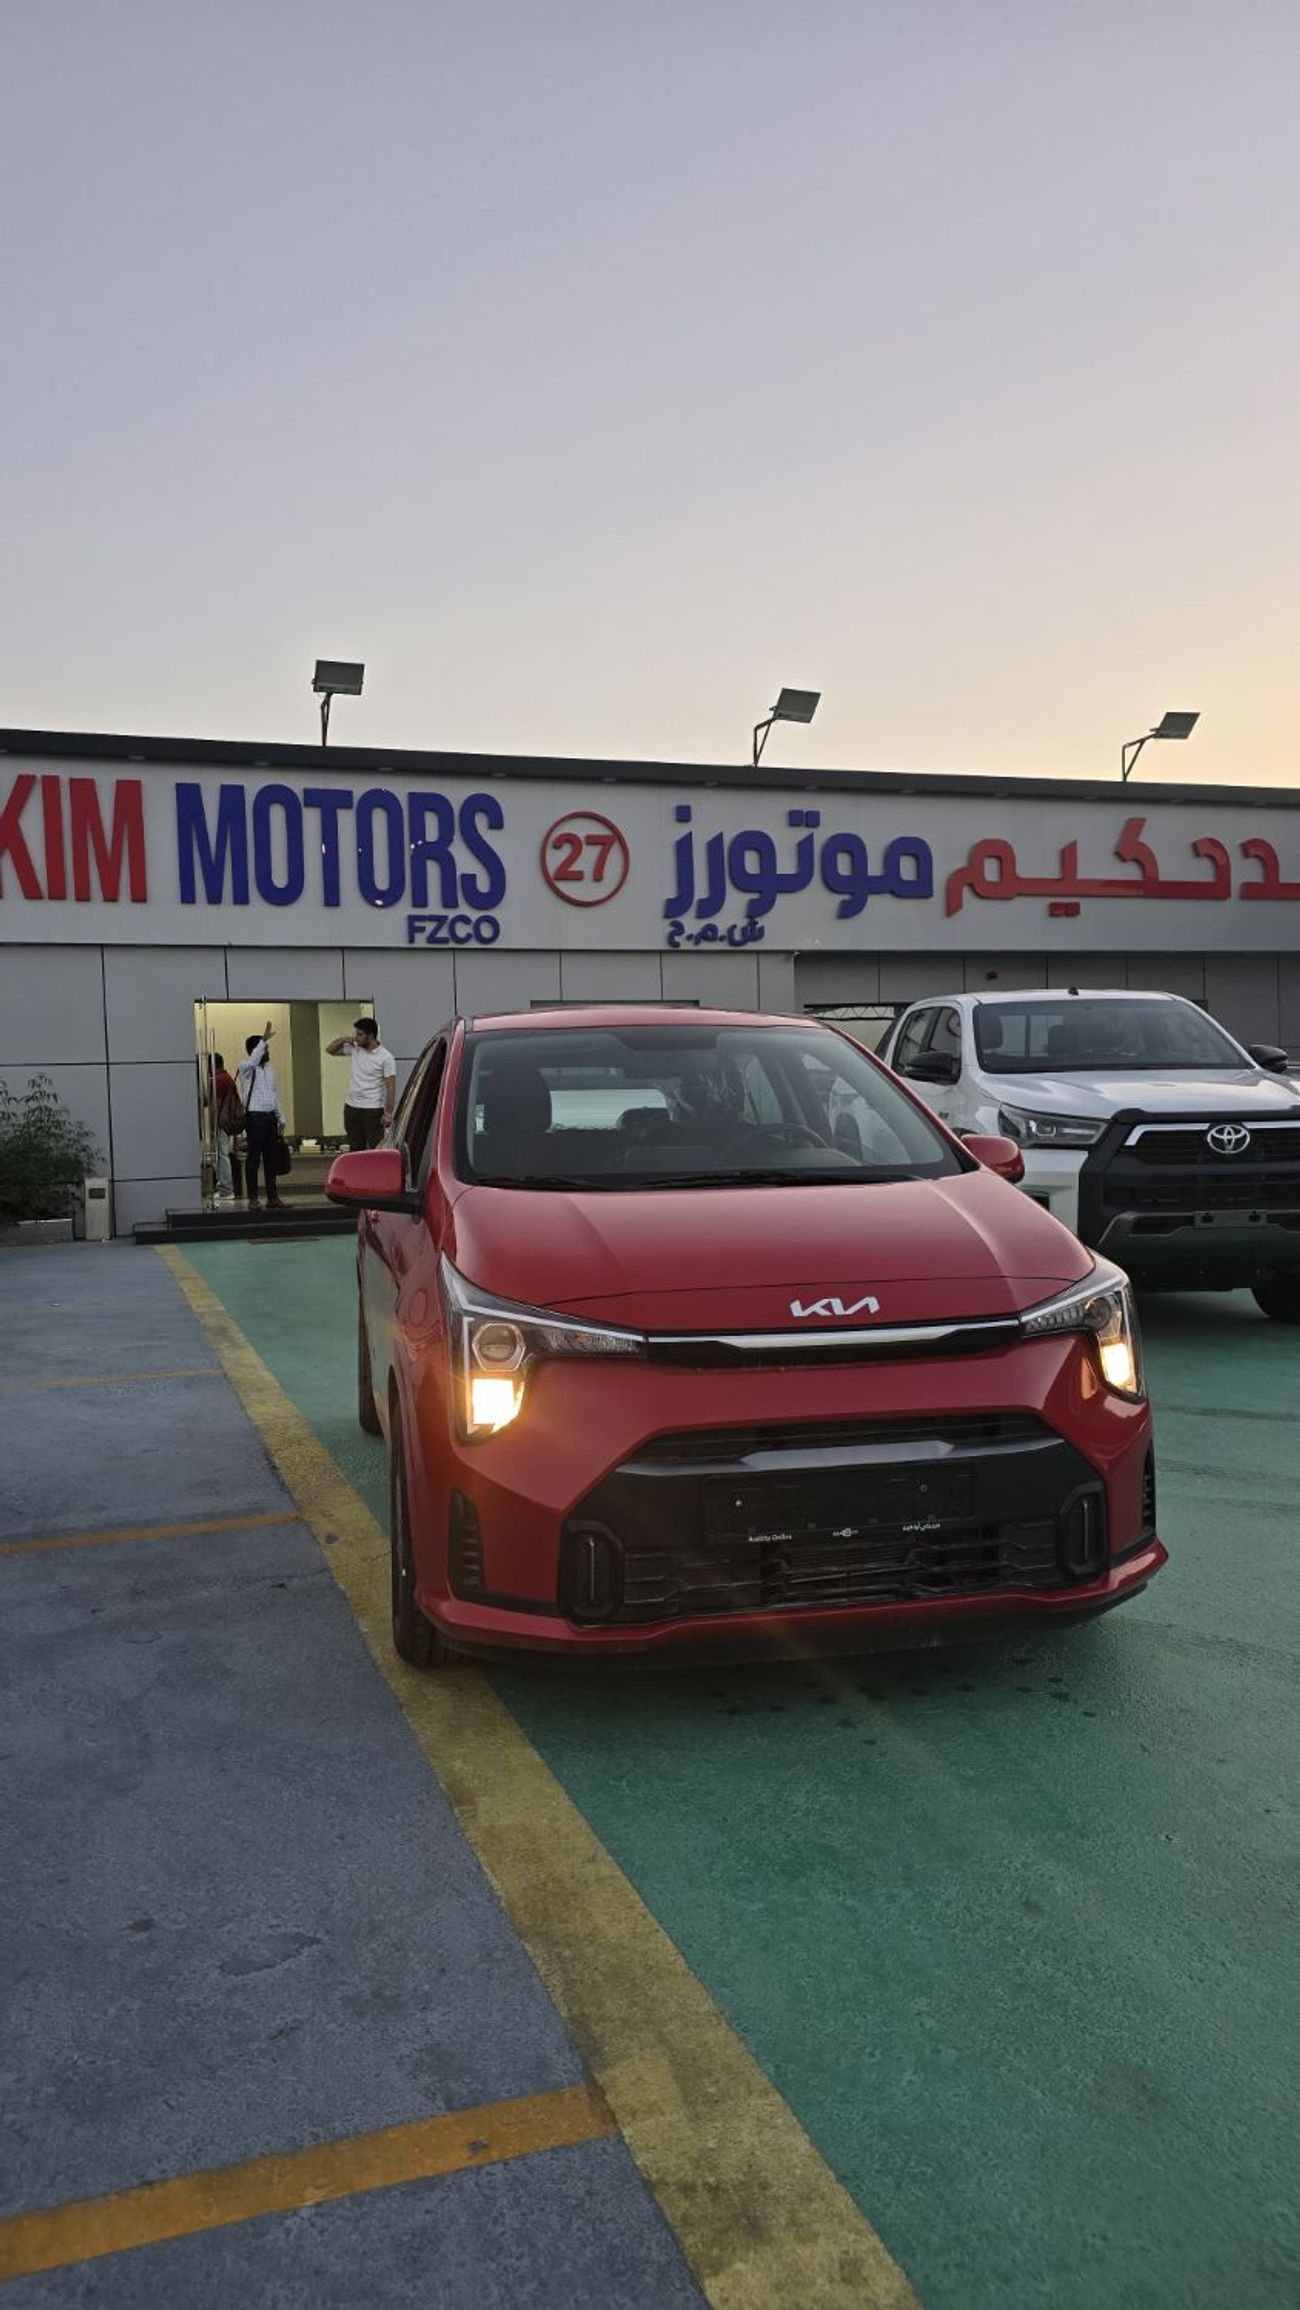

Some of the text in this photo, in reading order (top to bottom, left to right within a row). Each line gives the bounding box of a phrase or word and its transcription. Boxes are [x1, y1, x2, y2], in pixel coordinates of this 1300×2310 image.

[175, 781, 507, 911] MOTORS
[551, 832, 616, 882] 27
[664, 804, 935, 919] موتورز
[407, 914, 501, 944] FZCO
